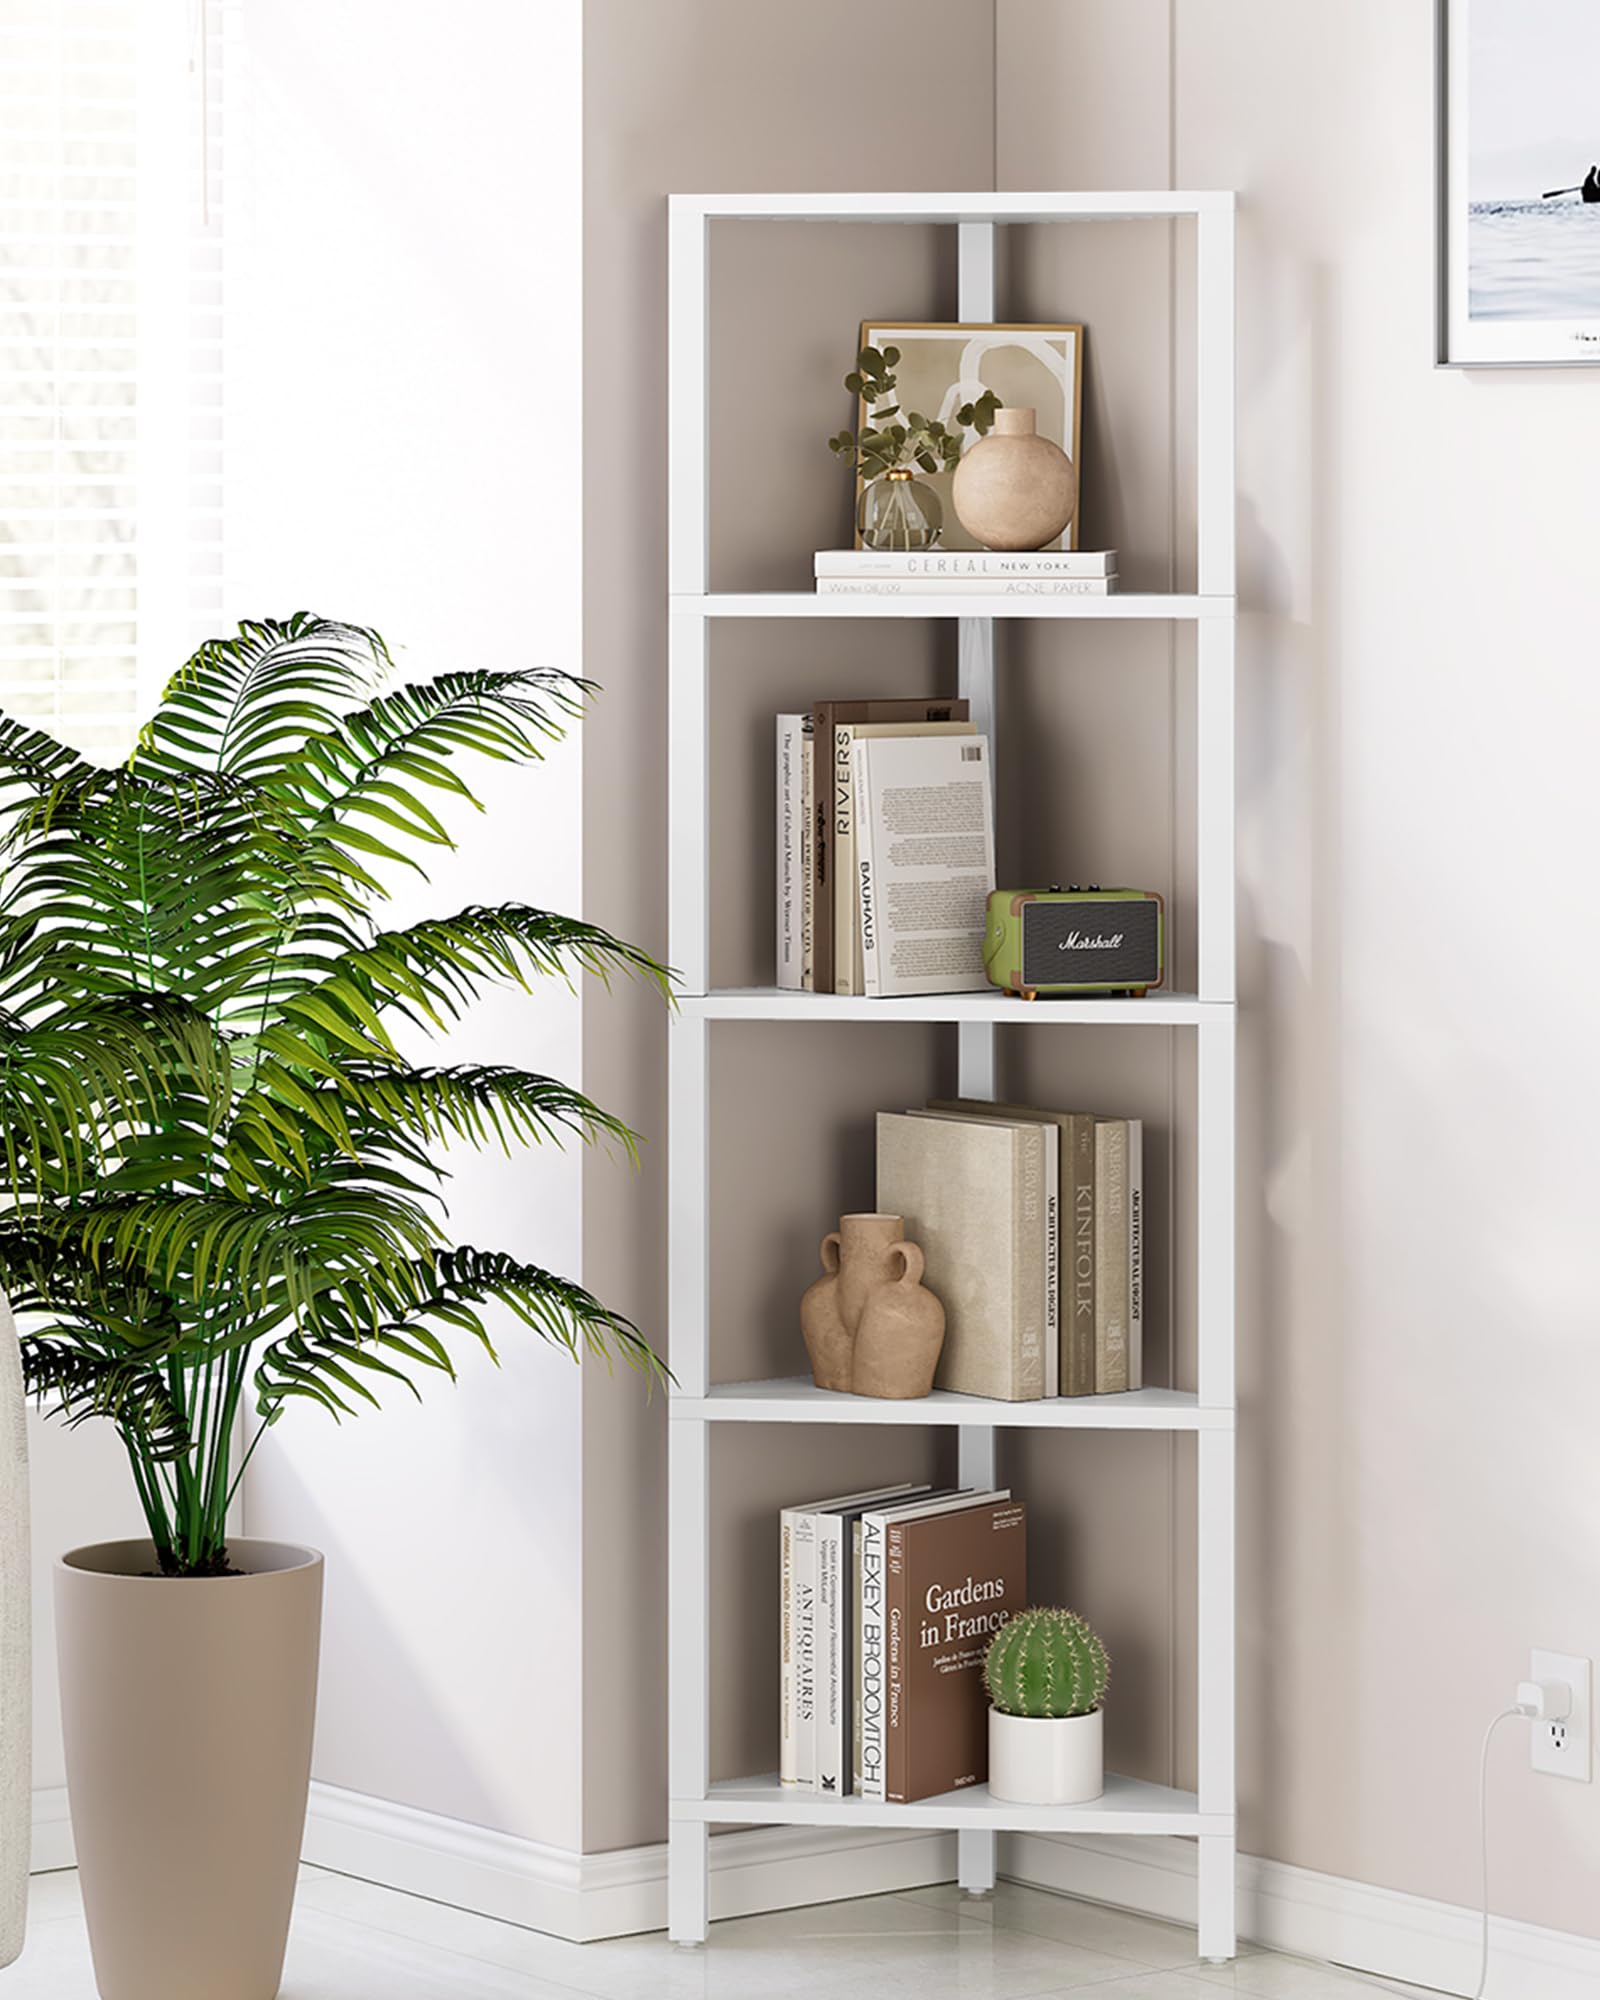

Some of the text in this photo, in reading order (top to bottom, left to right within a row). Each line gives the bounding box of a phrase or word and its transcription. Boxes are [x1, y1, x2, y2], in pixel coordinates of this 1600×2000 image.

[907, 558, 1070, 573] CEREAL NEW YORK
[1006, 582, 1092, 593] ACNE PAPER
[784, 732, 792, 749] The
[783, 751, 792, 786] graphic
[836, 730, 850, 836] RIVERS
[784, 802, 792, 814] of
[782, 885, 792, 897] by
[860, 861, 875, 950] BAUHAUS
[1058, 931, 1124, 950] Marshall
[1047, 1194, 1056, 1328] ARCHITECTURAL DIGEST
[1075, 1184, 1093, 1317] KINFOLK
[1131, 1188, 1141, 1321] ARCHITECTURAL DIGEST
[783, 1525, 791, 1569] FORMULA
[830, 1539, 838, 1563] Detail
[864, 1522, 882, 1618] ALEXEY
[783, 1577, 791, 1609] WORLD
[820, 1539, 828, 1604] Virginia McLeod
[926, 1576, 1004, 1613] Gardens
[829, 1573, 838, 1630] Contemporary
[783, 1611, 791, 1664] CHAMPIONS
[920, 1610, 1009, 1648] in France
[800, 1584, 813, 1721] ANTIQUAIRES
[830, 1631, 838, 1676] Residential
[889, 1607, 901, 1728] Gardens in France
[830, 1677, 838, 1725] Architecture
[864, 1623, 882, 1783] BRODOVITCH
